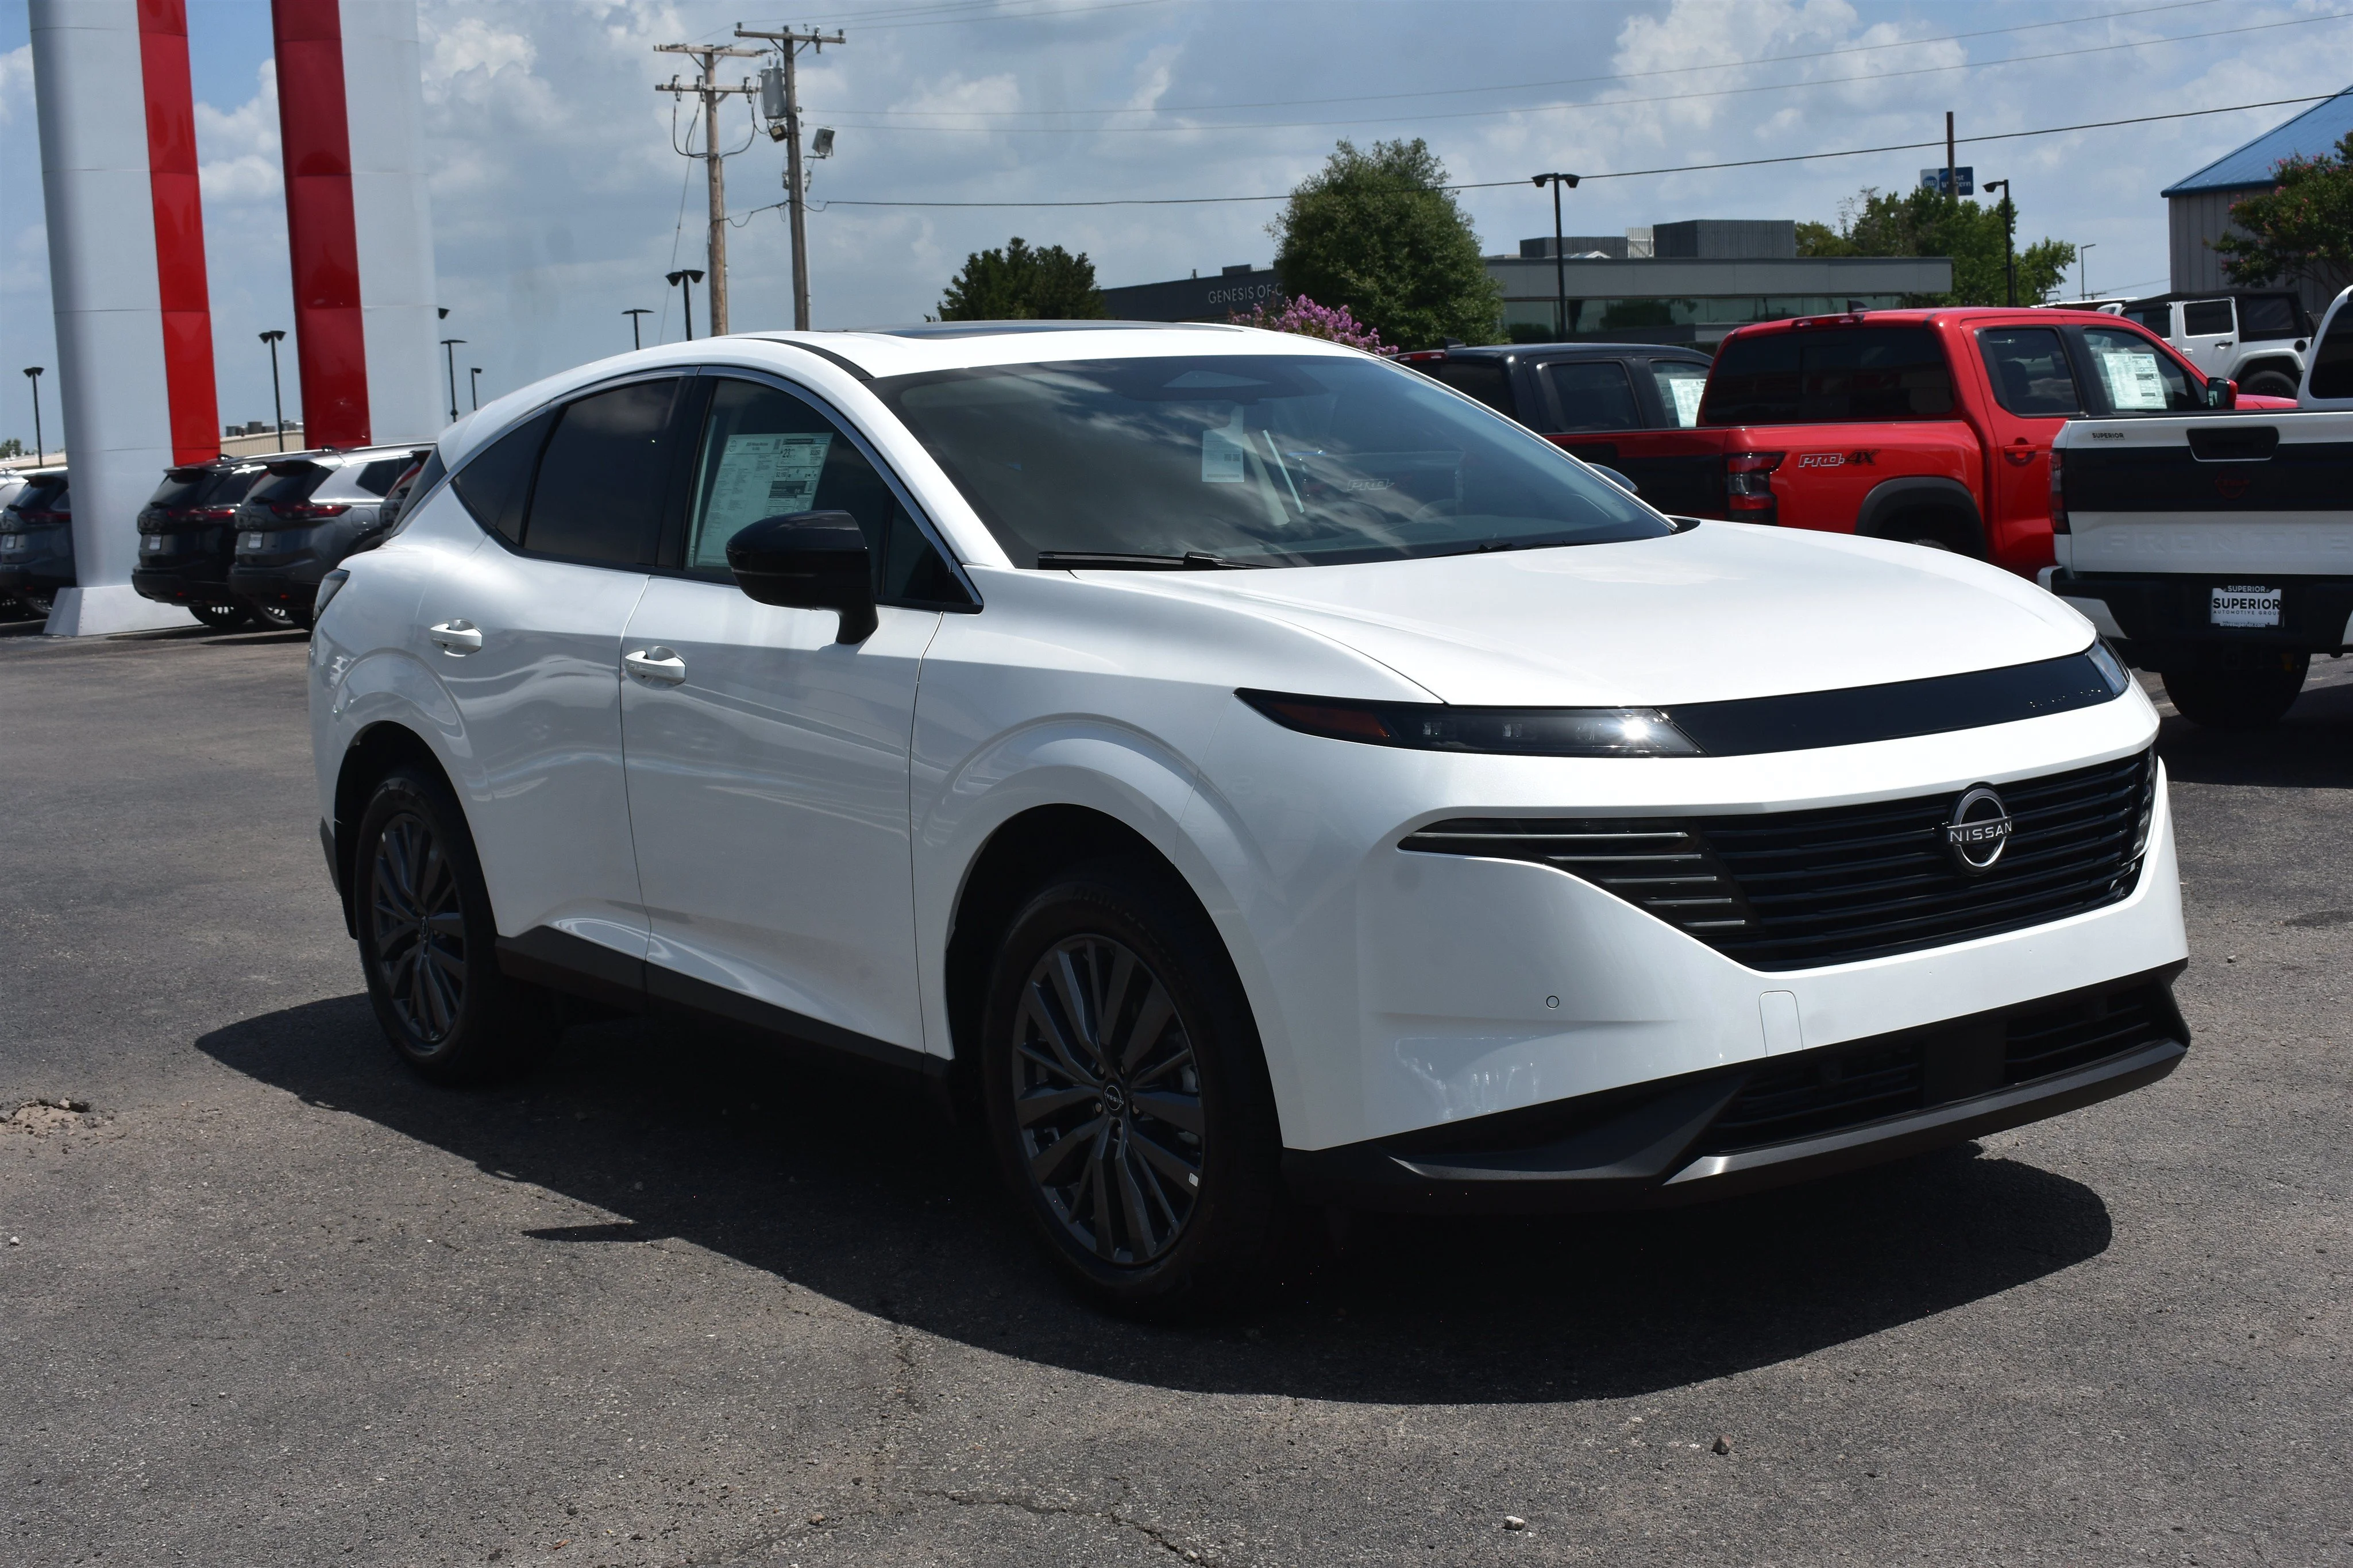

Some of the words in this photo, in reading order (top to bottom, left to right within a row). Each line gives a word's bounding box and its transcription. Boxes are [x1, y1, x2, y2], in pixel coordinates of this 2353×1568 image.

[1209, 286, 1254, 303] GENESIS
[1257, 284, 1271, 298] OF
[2213, 598, 2280, 609] SUPERIOR
[1950, 820, 2012, 842] NISSAN
